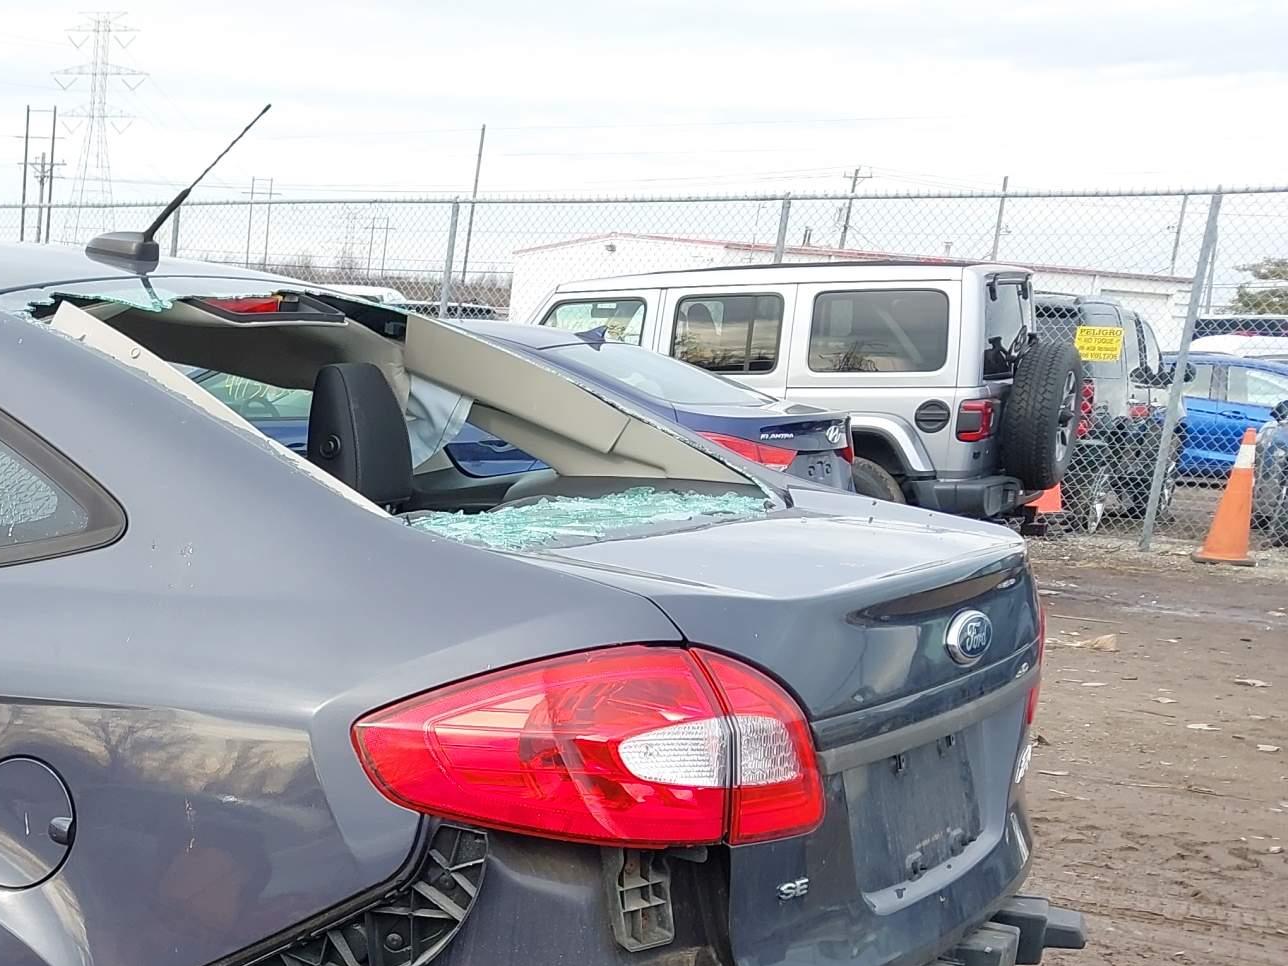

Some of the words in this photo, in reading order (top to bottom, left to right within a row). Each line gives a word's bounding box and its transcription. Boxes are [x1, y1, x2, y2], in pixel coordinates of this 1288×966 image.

[1079, 328, 1122, 337] PELIGRO
[965, 621, 987, 651] Ford
[778, 878, 809, 900] SE
